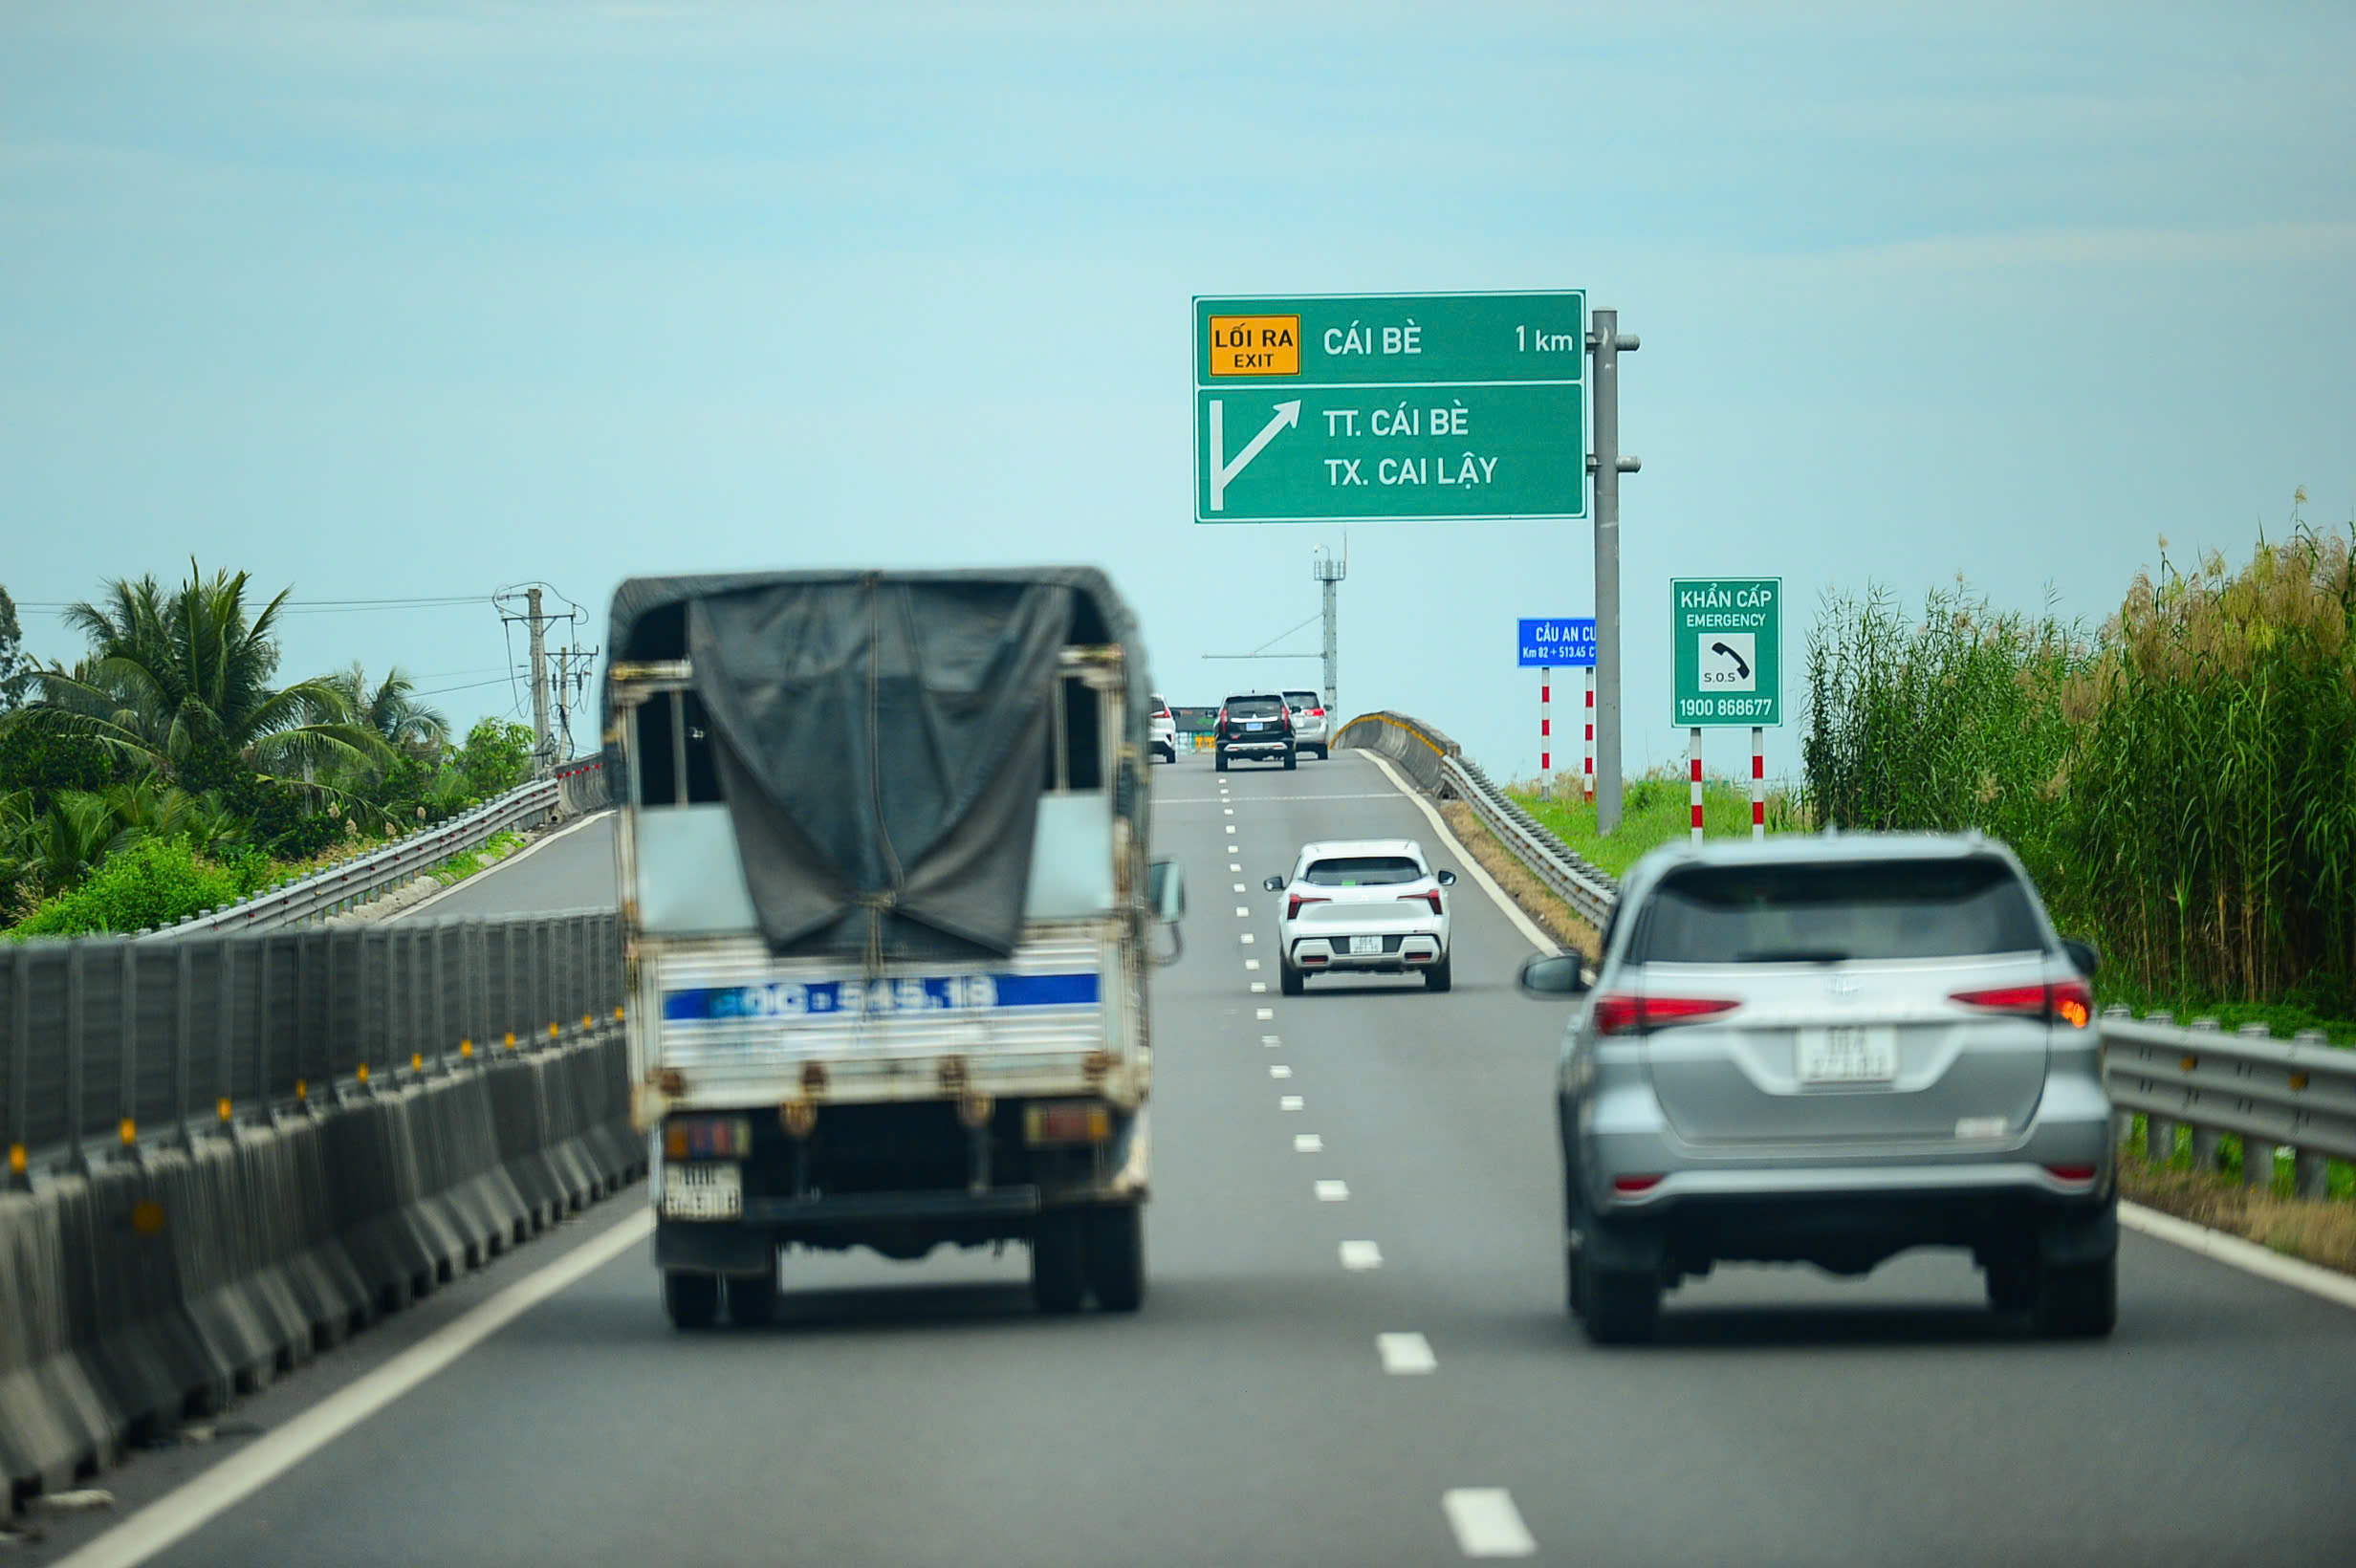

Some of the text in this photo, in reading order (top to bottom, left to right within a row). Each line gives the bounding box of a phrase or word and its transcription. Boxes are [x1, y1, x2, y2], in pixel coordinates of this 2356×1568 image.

[1215, 322, 1294, 348] LỐI RA
[1323, 318, 1422, 355] CÁI BÈ
[1516, 326, 1573, 352] 1 km
[1234, 354, 1275, 367] EXIT
[1322, 399, 1469, 436] TT. CÁI BÈ
[1324, 451, 1498, 490] TX. CAI LẬY
[1681, 582, 1772, 608] KHẨN CẤP
[1686, 614, 1766, 627] EMERGENCY
[1562, 626, 1579, 642] AN
[1522, 646, 1537, 659] Km
[1538, 646, 1548, 658] 82
[1559, 646, 1586, 658] 513.45
[1704, 672, 1735, 683] S.O.S
[1680, 698, 1772, 716] 1900 868677
